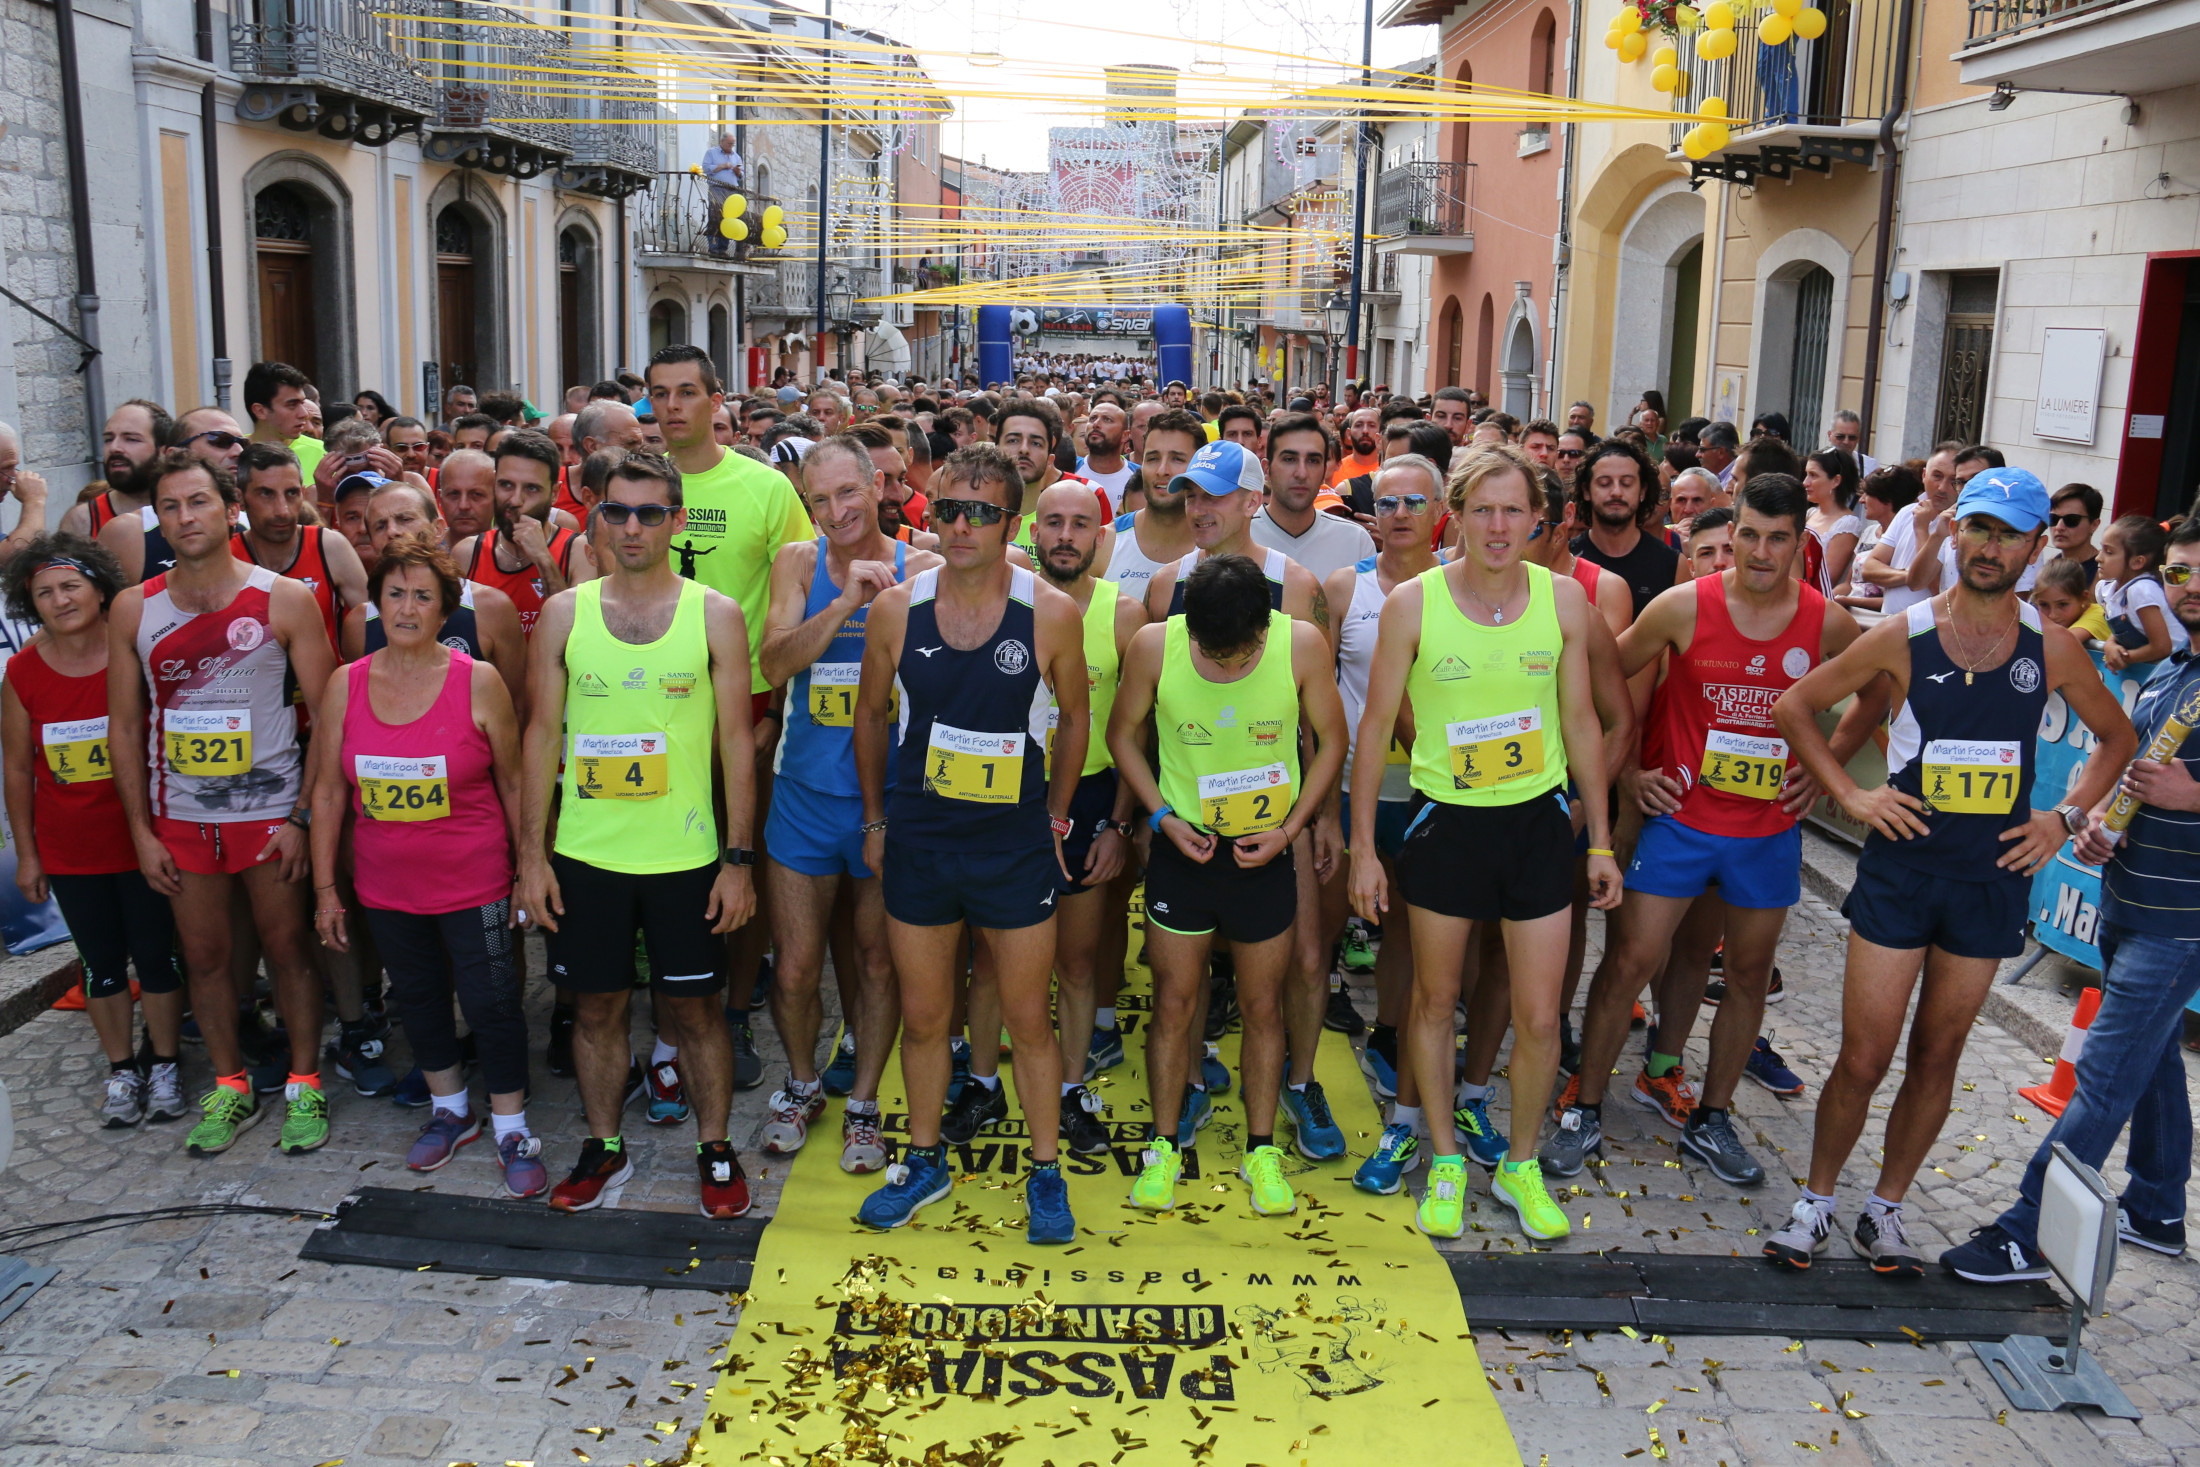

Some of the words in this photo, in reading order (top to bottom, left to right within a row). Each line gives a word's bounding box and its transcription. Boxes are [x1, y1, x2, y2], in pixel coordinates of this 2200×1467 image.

[1114, 310, 1151, 318] PUNTO
[2041, 397, 2051, 410] LA
[1190, 460, 1216, 470] adidas
[688, 508, 727, 522] SSIATA
[159, 659, 192, 681] La
[198, 656, 257, 686] Vigna
[816, 667, 844, 676] Martin
[846, 667, 860, 676] Fo
[1705, 686, 1782, 706] CASEIFIC
[171, 714, 196, 724] Martin
[197, 715, 223, 724] Food
[1456, 723, 1489, 736] Martin
[1490, 718, 1516, 731] Food
[51, 726, 78, 736] Martin
[80, 721, 106, 732] Food
[582, 738, 609, 748] Martin
[611, 738, 638, 748] Food
[940, 730, 970, 745] Martin
[972, 736, 1000, 748] Food
[1715, 735, 1746, 748] Martin
[1746, 741, 1770, 751] Food
[88, 743, 110, 767] 4
[190, 738, 243, 763] 321
[1504, 741, 1523, 767] 3
[1932, 743, 1966, 756] Martin
[1967, 746, 1997, 756] Food
[364, 760, 392, 770] Martin
[393, 762, 419, 772] Food
[625, 762, 644, 787] 4
[1731, 760, 1783, 788] 319
[981, 762, 995, 789] 1
[1208, 776, 1239, 789] Martin
[1240, 772, 1266, 784] Food
[1498, 773, 1516, 781] ANGELO
[1958, 771, 2014, 799] 171
[386, 783, 444, 810] 264
[959, 791, 988, 799] ANTONELLO
[1252, 794, 1272, 820] 2
[267, 825, 281, 835] JO
[2052, 881, 2099, 947] Ma
[833, 1339, 1236, 1402] PASSIAA
